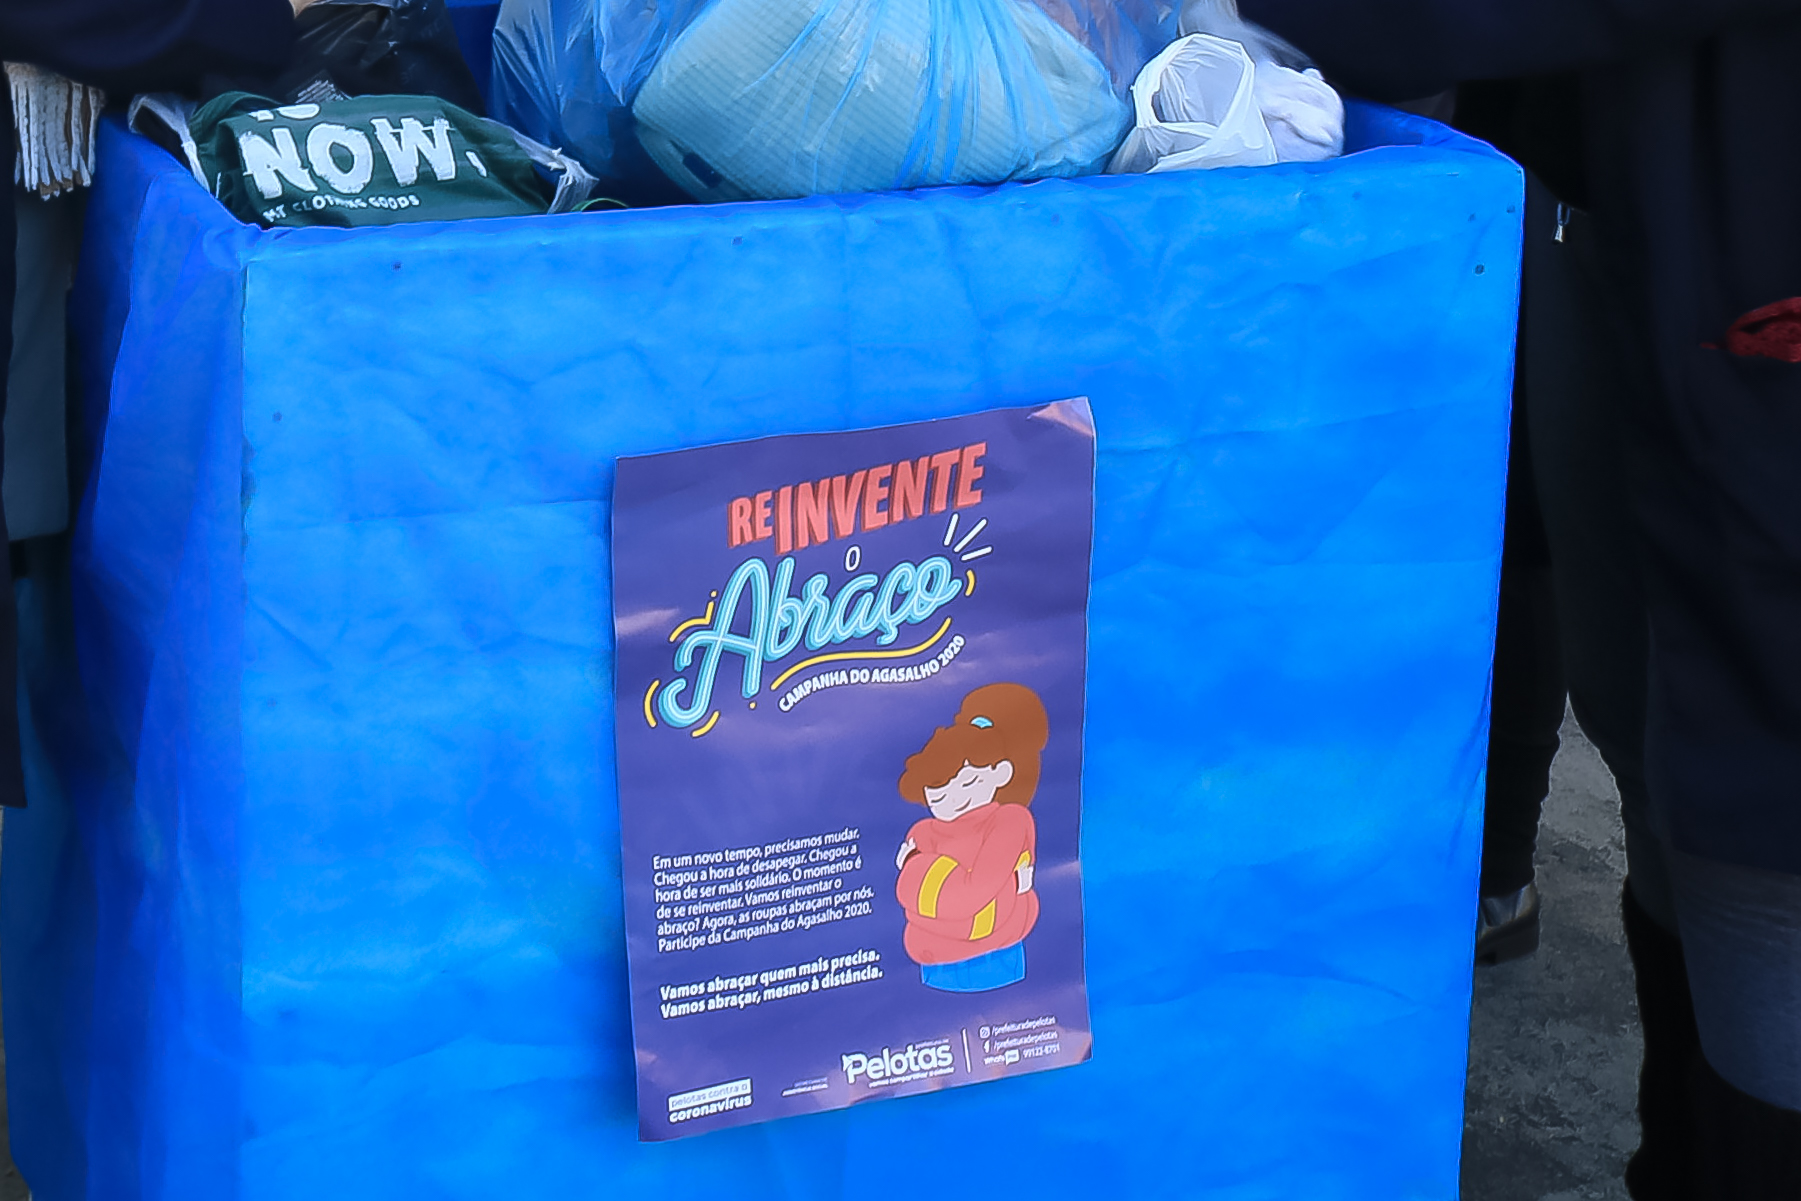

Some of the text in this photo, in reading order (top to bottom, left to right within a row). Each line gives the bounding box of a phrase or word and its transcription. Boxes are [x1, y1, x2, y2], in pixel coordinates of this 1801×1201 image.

[658, 556, 962, 727] Abraço
[779, 635, 966, 712] CAMPANHA DO AGASALHO 2020
[653, 827, 860, 870] Em um novo tempo, precisamos mudar.
[654, 844, 857, 887] Chegou a hora de desapegar. Chegou a
[655, 855, 862, 903] hora de ser mais solidário. O momento é
[656, 878, 842, 919] de se reinventar. Vamos reinventar o
[657, 885, 874, 936] abraço? Agora, as roupas abraçam por nós.
[658, 901, 872, 952] Participe da Campanha do Agasalho 2020.
[660, 949, 880, 1001] Vamos abraçar quem mais precisa.
[660, 965, 883, 1019] Vamos abraçar, mesmo à distância.
[841, 1044, 954, 1084] Pelotas
[669, 1095, 752, 1123] coronavírus
